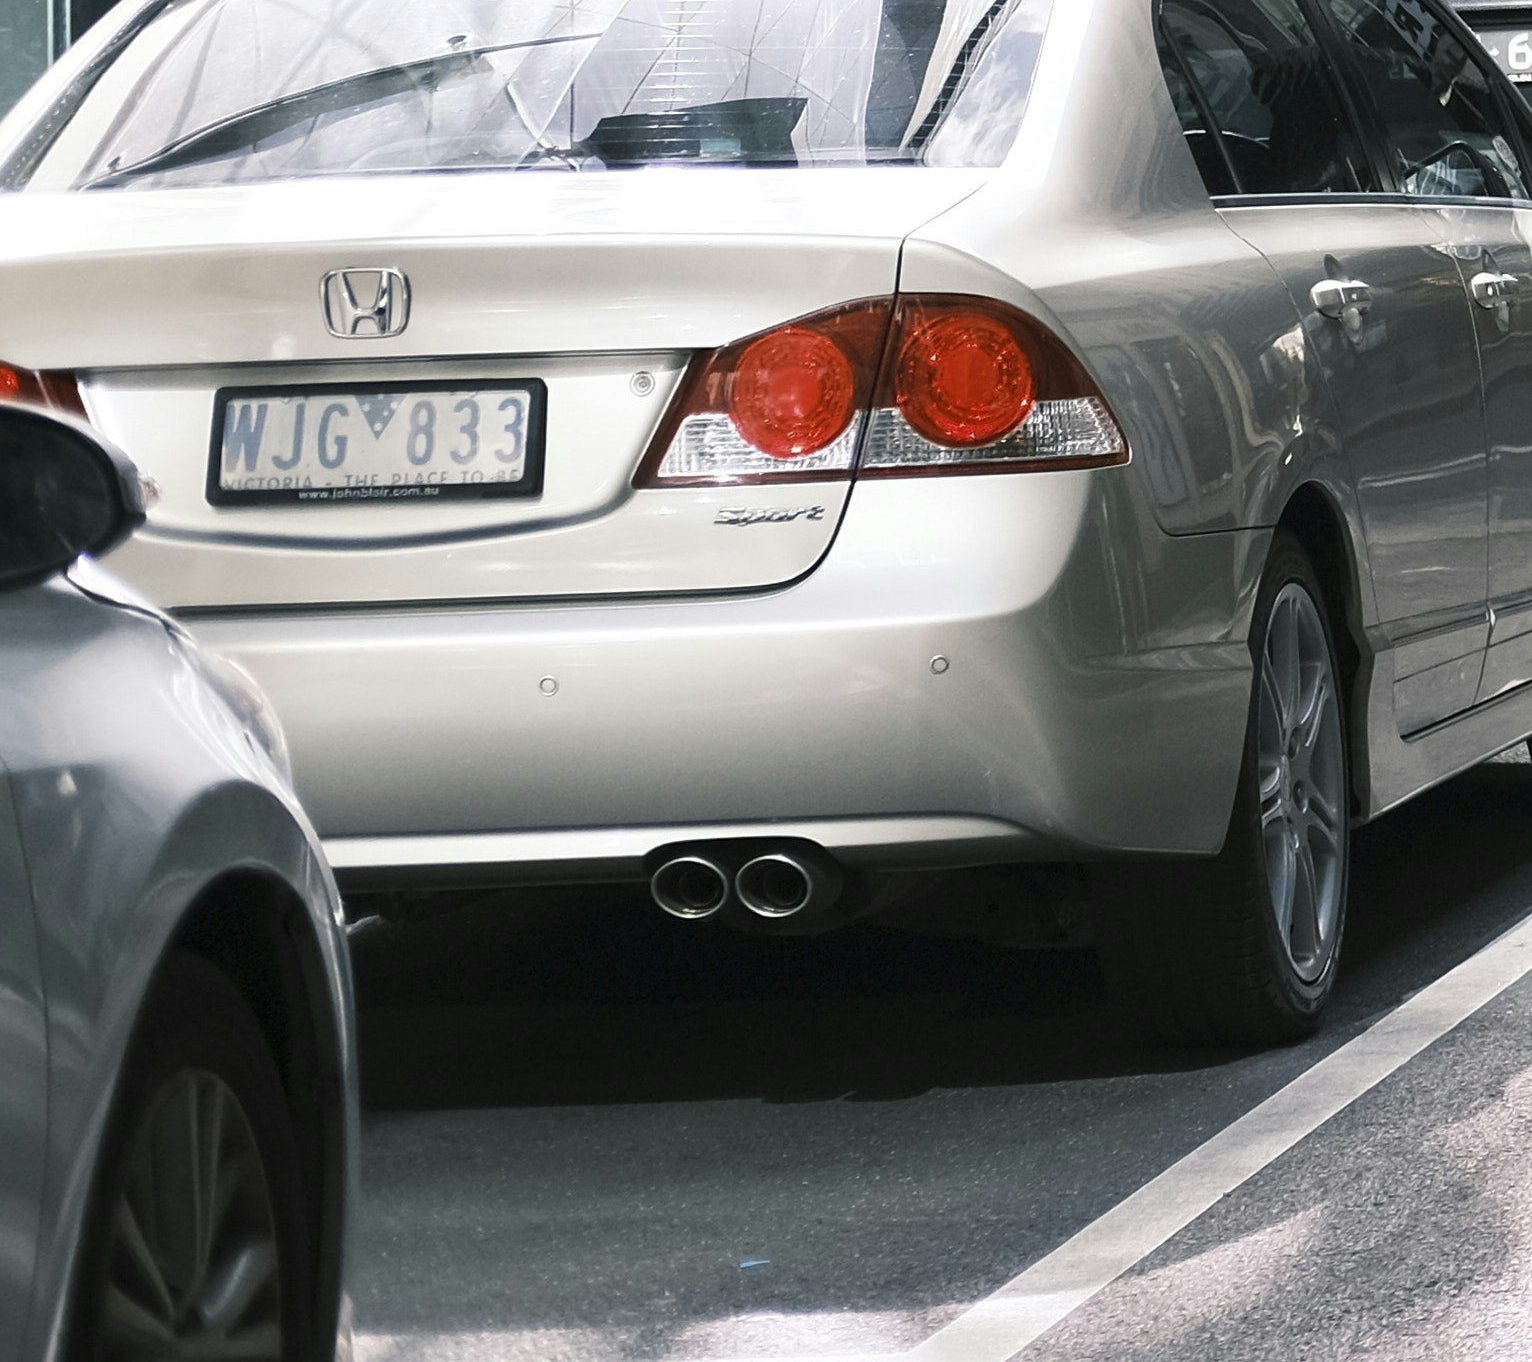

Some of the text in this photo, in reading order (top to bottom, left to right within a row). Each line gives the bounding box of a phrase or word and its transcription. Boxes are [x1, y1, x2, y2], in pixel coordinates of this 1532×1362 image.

[223, 396, 526, 473] WJG 833
[224, 475, 313, 490] VICTORIA
[344, 474, 377, 487] THE
[391, 471, 448, 486] PLACE
[461, 470, 483, 483] TO
[713, 504, 825, 527] Sport
